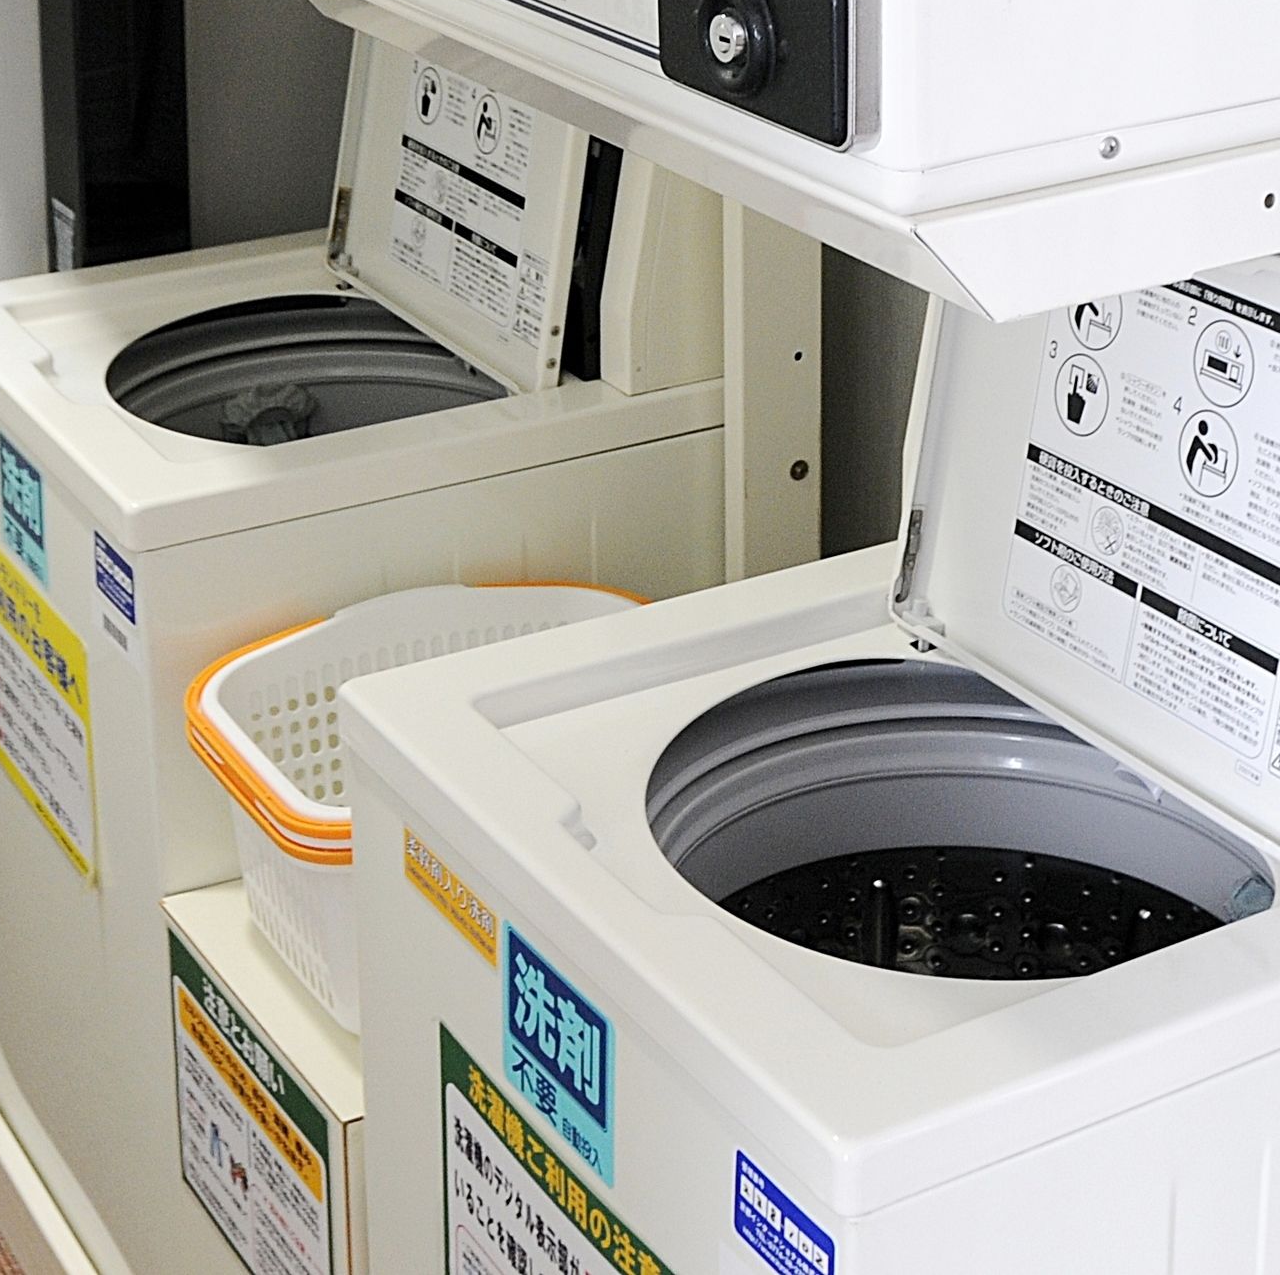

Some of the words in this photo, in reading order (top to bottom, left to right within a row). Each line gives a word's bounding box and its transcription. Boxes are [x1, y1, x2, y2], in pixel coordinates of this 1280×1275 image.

[1187, 306, 1198, 327] 2
[1048, 339, 1058, 359] 3
[1173, 394, 1183, 414] 4
[1038, 449, 1150, 518] 硬貨を投入するときのご注意
[1033, 528, 1115, 586] ソフト剤のご使用方法
[514, 953, 600, 1105] 洗剤
[512, 1044, 557, 1127] 不要
[562, 1118, 603, 1175] 自動投入
[453, 1168, 544, 1275] いることを確認し
